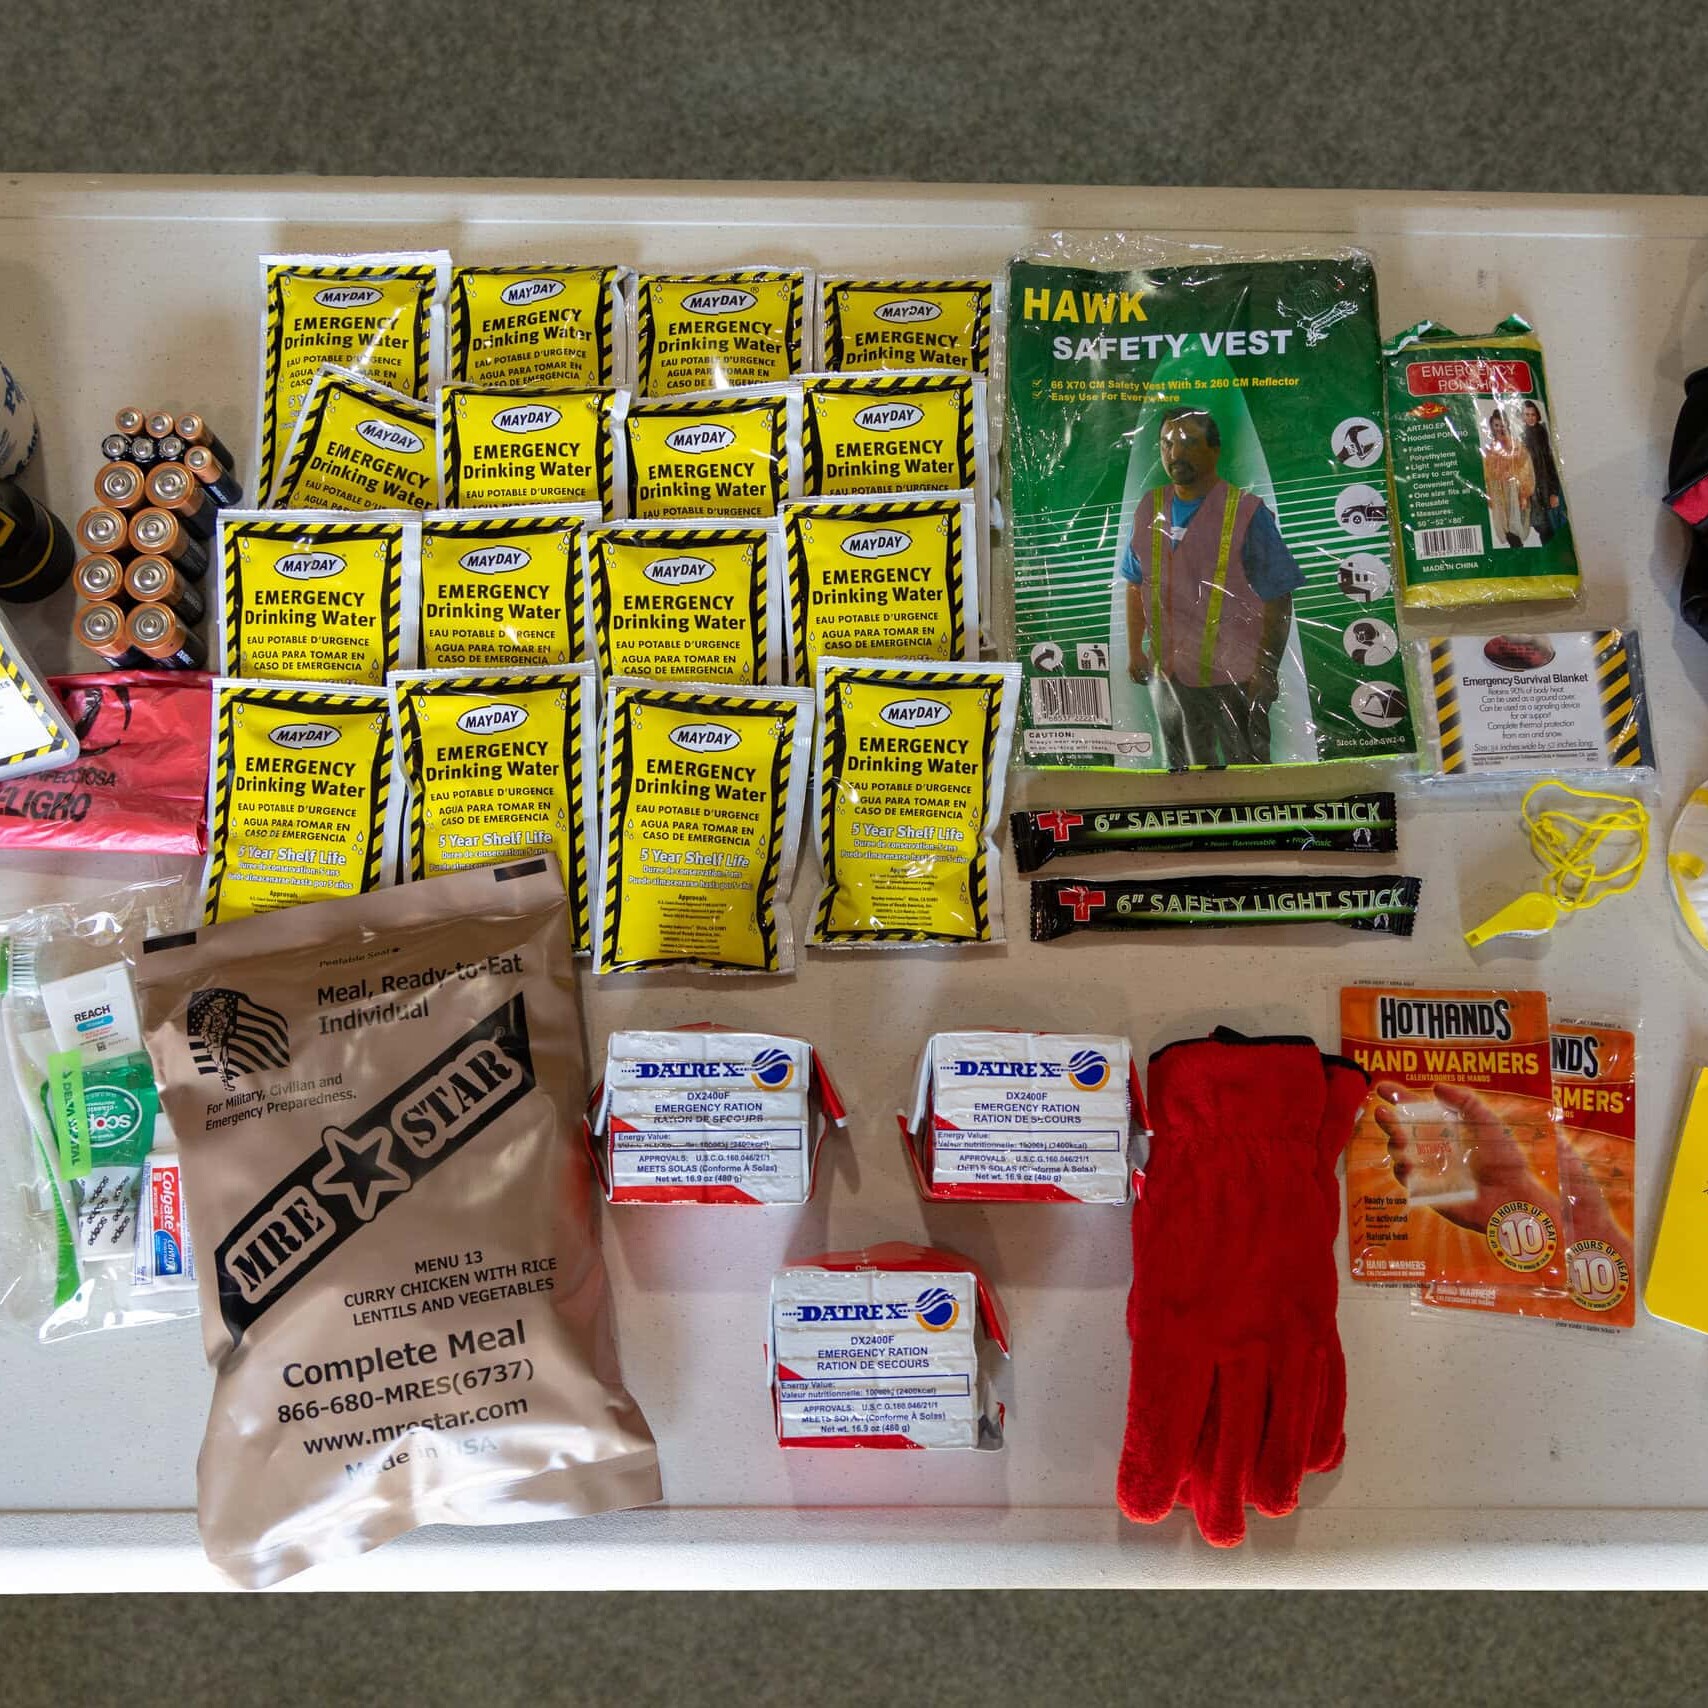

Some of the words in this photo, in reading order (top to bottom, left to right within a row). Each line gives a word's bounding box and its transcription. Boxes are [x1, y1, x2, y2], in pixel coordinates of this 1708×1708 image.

[509, 283, 556, 301] MAYDAY
[690, 295, 747, 308] MAYDAY
[1023, 288, 1149, 324] HAWK
[882, 305, 932, 317] MAYDAY
[482, 309, 581, 332] EMERGENCY
[668, 321, 773, 336] EMERGENCY
[473, 329, 539, 351] Drinking
[544, 325, 592, 343] Water
[658, 338, 730, 354] Drinking
[734, 339, 782, 354] Water
[855, 332, 958, 348] EMERGENCY
[1052, 334, 1193, 361] SAFETY
[1200, 330, 1292, 357] VEST
[846, 351, 914, 365] Drinking
[919, 352, 967, 367] Water
[1108, 380, 1140, 391] Safety
[1167, 380, 1192, 390] With
[1232, 378, 1249, 387] CM
[1252, 377, 1299, 387] Reflector
[501, 411, 552, 426] MAYDAY
[673, 431, 725, 446] MAYDAY
[474, 443, 581, 459] EMERGENCY
[463, 463, 536, 480] Drinking
[539, 464, 591, 479] Water
[648, 463, 755, 480] EMERGENCY
[639, 483, 711, 500] Drinking
[714, 483, 766, 497] Water
[850, 535, 902, 551] MAYDAY
[283, 559, 337, 572] MAYDAY
[652, 563, 706, 579] MAYDAY
[1455, 561, 1478, 570] CHINA
[822, 567, 932, 585] EMERGENCY
[254, 590, 365, 606] EMERGENCY
[623, 595, 733, 611] EMERGENCY
[813, 588, 888, 606] Drinking
[892, 587, 943, 602] Water
[245, 609, 316, 627] Drinking
[320, 611, 376, 626] Water
[613, 615, 692, 633] Drinking
[694, 616, 746, 630] Water
[684, 640, 740, 649] D'URGENCE
[621, 655, 648, 663] AGUA
[653, 655, 678, 663] PARA
[682, 655, 719, 663] TOMAR
[722, 655, 736, 663] EN
[623, 666, 649, 674] CASO
[654, 666, 667, 674] DE
[670, 666, 733, 674] EMERGENCIA
[1462, 677, 1512, 687] Emergency
[1513, 675, 1551, 685] Survival
[1553, 673, 1588, 683] Blanket
[465, 711, 519, 727] MAYDAY
[888, 706, 942, 721] MAYDAY
[276, 729, 332, 742] MAYDAY
[678, 730, 731, 745] MAYDAY
[437, 741, 548, 761] EMERGENCY
[859, 737, 969, 755] EMERGENCY
[246, 757, 356, 777] EMERGENCY
[425, 764, 503, 782] Drinking
[508, 761, 559, 777] Water
[647, 759, 755, 779] EMERGENCY
[848, 756, 922, 776] Drinking
[927, 759, 978, 776] Water
[236, 777, 305, 797] Drinking
[311, 779, 366, 798] Water
[635, 778, 710, 800] Drinking
[716, 785, 767, 803] Water
[1128, 808, 1222, 831] SAFETY
[1229, 805, 1306, 825] LIGHT
[1313, 802, 1380, 823] STICK
[1150, 894, 1245, 914] SAFETY
[1254, 893, 1330, 913] LIGHT
[1338, 889, 1403, 911] STICK
[317, 979, 374, 1006] Meal,
[381, 953, 524, 993] Ready-to-Eat
[73, 1004, 111, 1023] REACH
[318, 997, 430, 1035] Individual
[1380, 998, 1512, 1041] HOTHANDS
[636, 1062, 745, 1078] DATREX
[954, 1061, 1062, 1077] DATREX
[1354, 1050, 1417, 1072] HAND
[1424, 1051, 1540, 1075] WARMERS
[206, 1102, 223, 1115] For
[226, 1089, 266, 1110] Military,
[269, 1078, 315, 1097] Civilian
[319, 1073, 343, 1087] and
[400, 1048, 513, 1148] STAR
[1006, 1092, 1048, 1101] DX2400F
[1554, 1086, 1624, 1114] RMERS
[205, 1106, 264, 1131] Emergency
[266, 1088, 357, 1114] Preparedness.
[655, 1103, 721, 1113] EMERGENCY
[724, 1102, 763, 1112] RATION
[974, 1103, 1039, 1113] EMERGENCY
[1041, 1104, 1080, 1113] RATION
[973, 1115, 1012, 1124] RATION
[1015, 1115, 1029, 1123] DE
[160, 1170, 176, 1230] Colgate
[1498, 1203, 1529, 1217] HOURS
[1531, 1207, 1543, 1217] OF
[1542, 1217, 1556, 1241] HEAT
[232, 1196, 326, 1292] MRE
[1501, 1219, 1544, 1256] 10
[414, 1255, 460, 1275] MENU
[464, 1250, 484, 1266] 13
[1571, 1241, 1604, 1254] HOURS
[1605, 1247, 1616, 1257] OF
[1615, 1259, 1629, 1283] HEAT
[343, 1285, 396, 1309] CURRY
[400, 1273, 470, 1297] CHICKEN
[474, 1264, 518, 1284] WITH
[521, 1258, 558, 1276] RICE
[1573, 1258, 1616, 1294] 10
[352, 1304, 419, 1327] LENTILS
[421, 1295, 455, 1316] AND
[458, 1277, 555, 1308] VEGETABLES
[797, 1303, 909, 1322] DATREX
[850, 1336, 895, 1345] DX2400F
[282, 1341, 438, 1389] Complete
[448, 1320, 527, 1359] Meal
[818, 1349, 885, 1359] EMERGENCY
[888, 1347, 928, 1356] RATION
[817, 1360, 857, 1370] RATION
[860, 1360, 875, 1369] DE
[877, 1359, 930, 1369] SECOURS
[277, 1358, 536, 1424] 866-680-MRES(6737)
